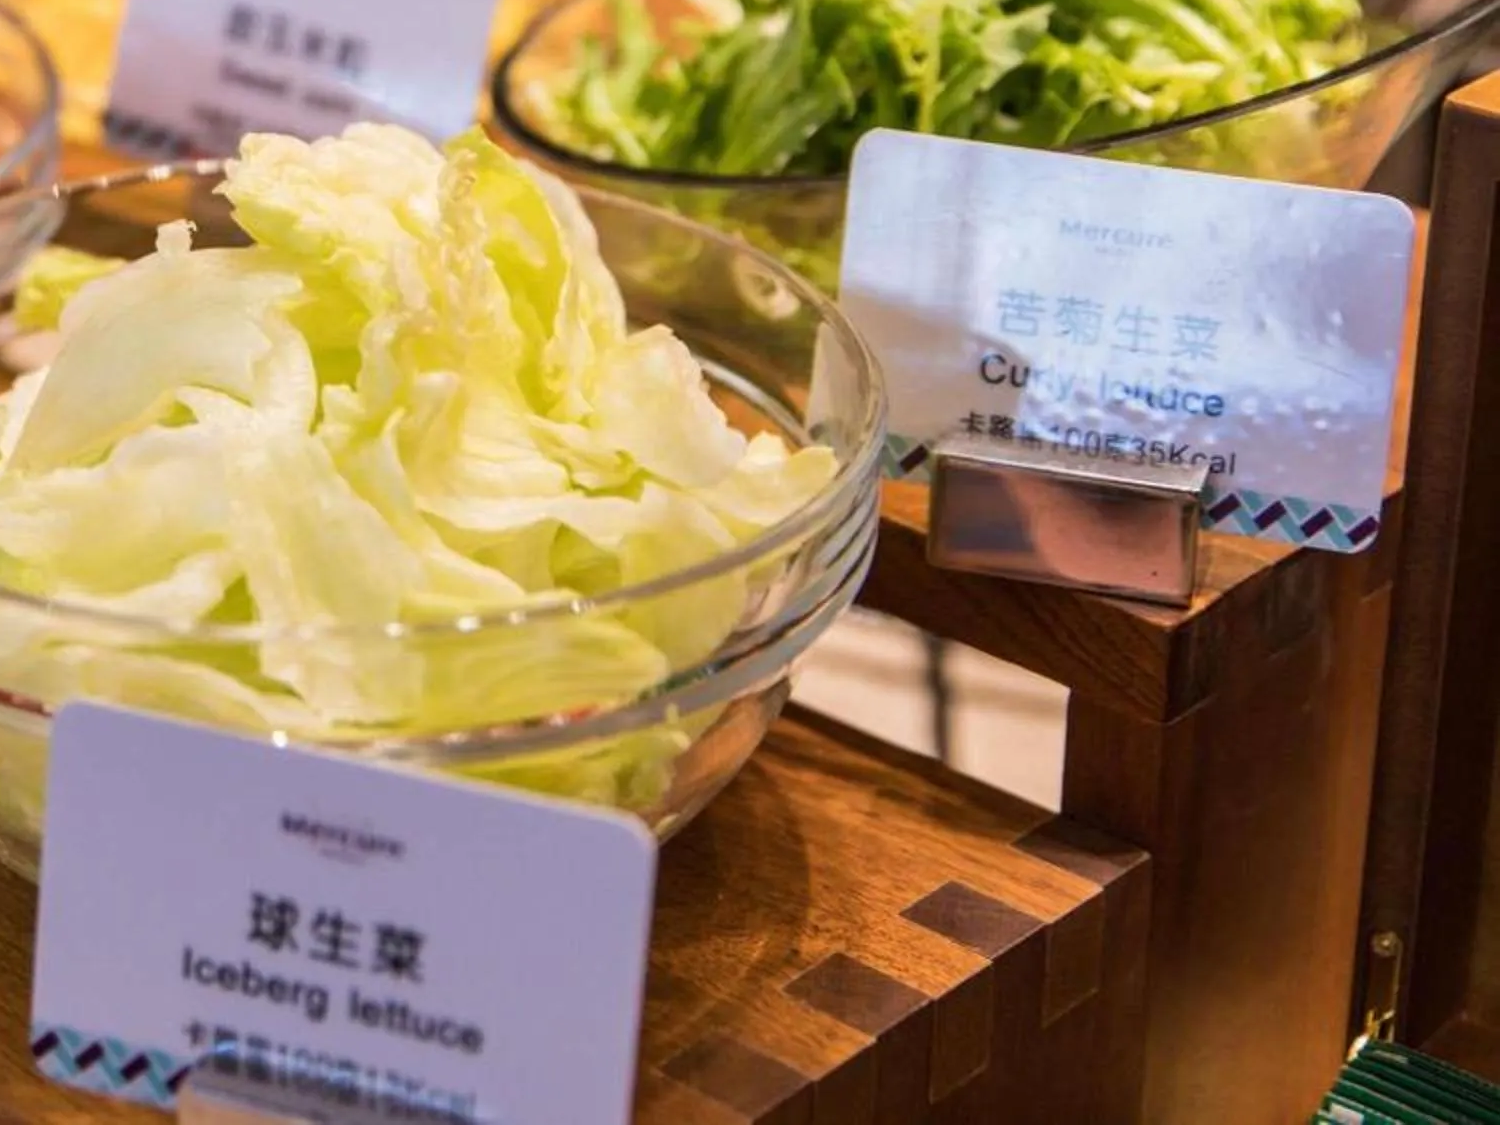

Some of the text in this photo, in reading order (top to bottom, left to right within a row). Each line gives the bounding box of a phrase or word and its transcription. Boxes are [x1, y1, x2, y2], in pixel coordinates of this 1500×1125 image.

[1060, 220, 1172, 248] Mercure
[998, 288, 1221, 360] 苦菊生菜
[246, 892, 425, 982] 球生菜
[181, 947, 484, 1053] Iceberg lettuce
